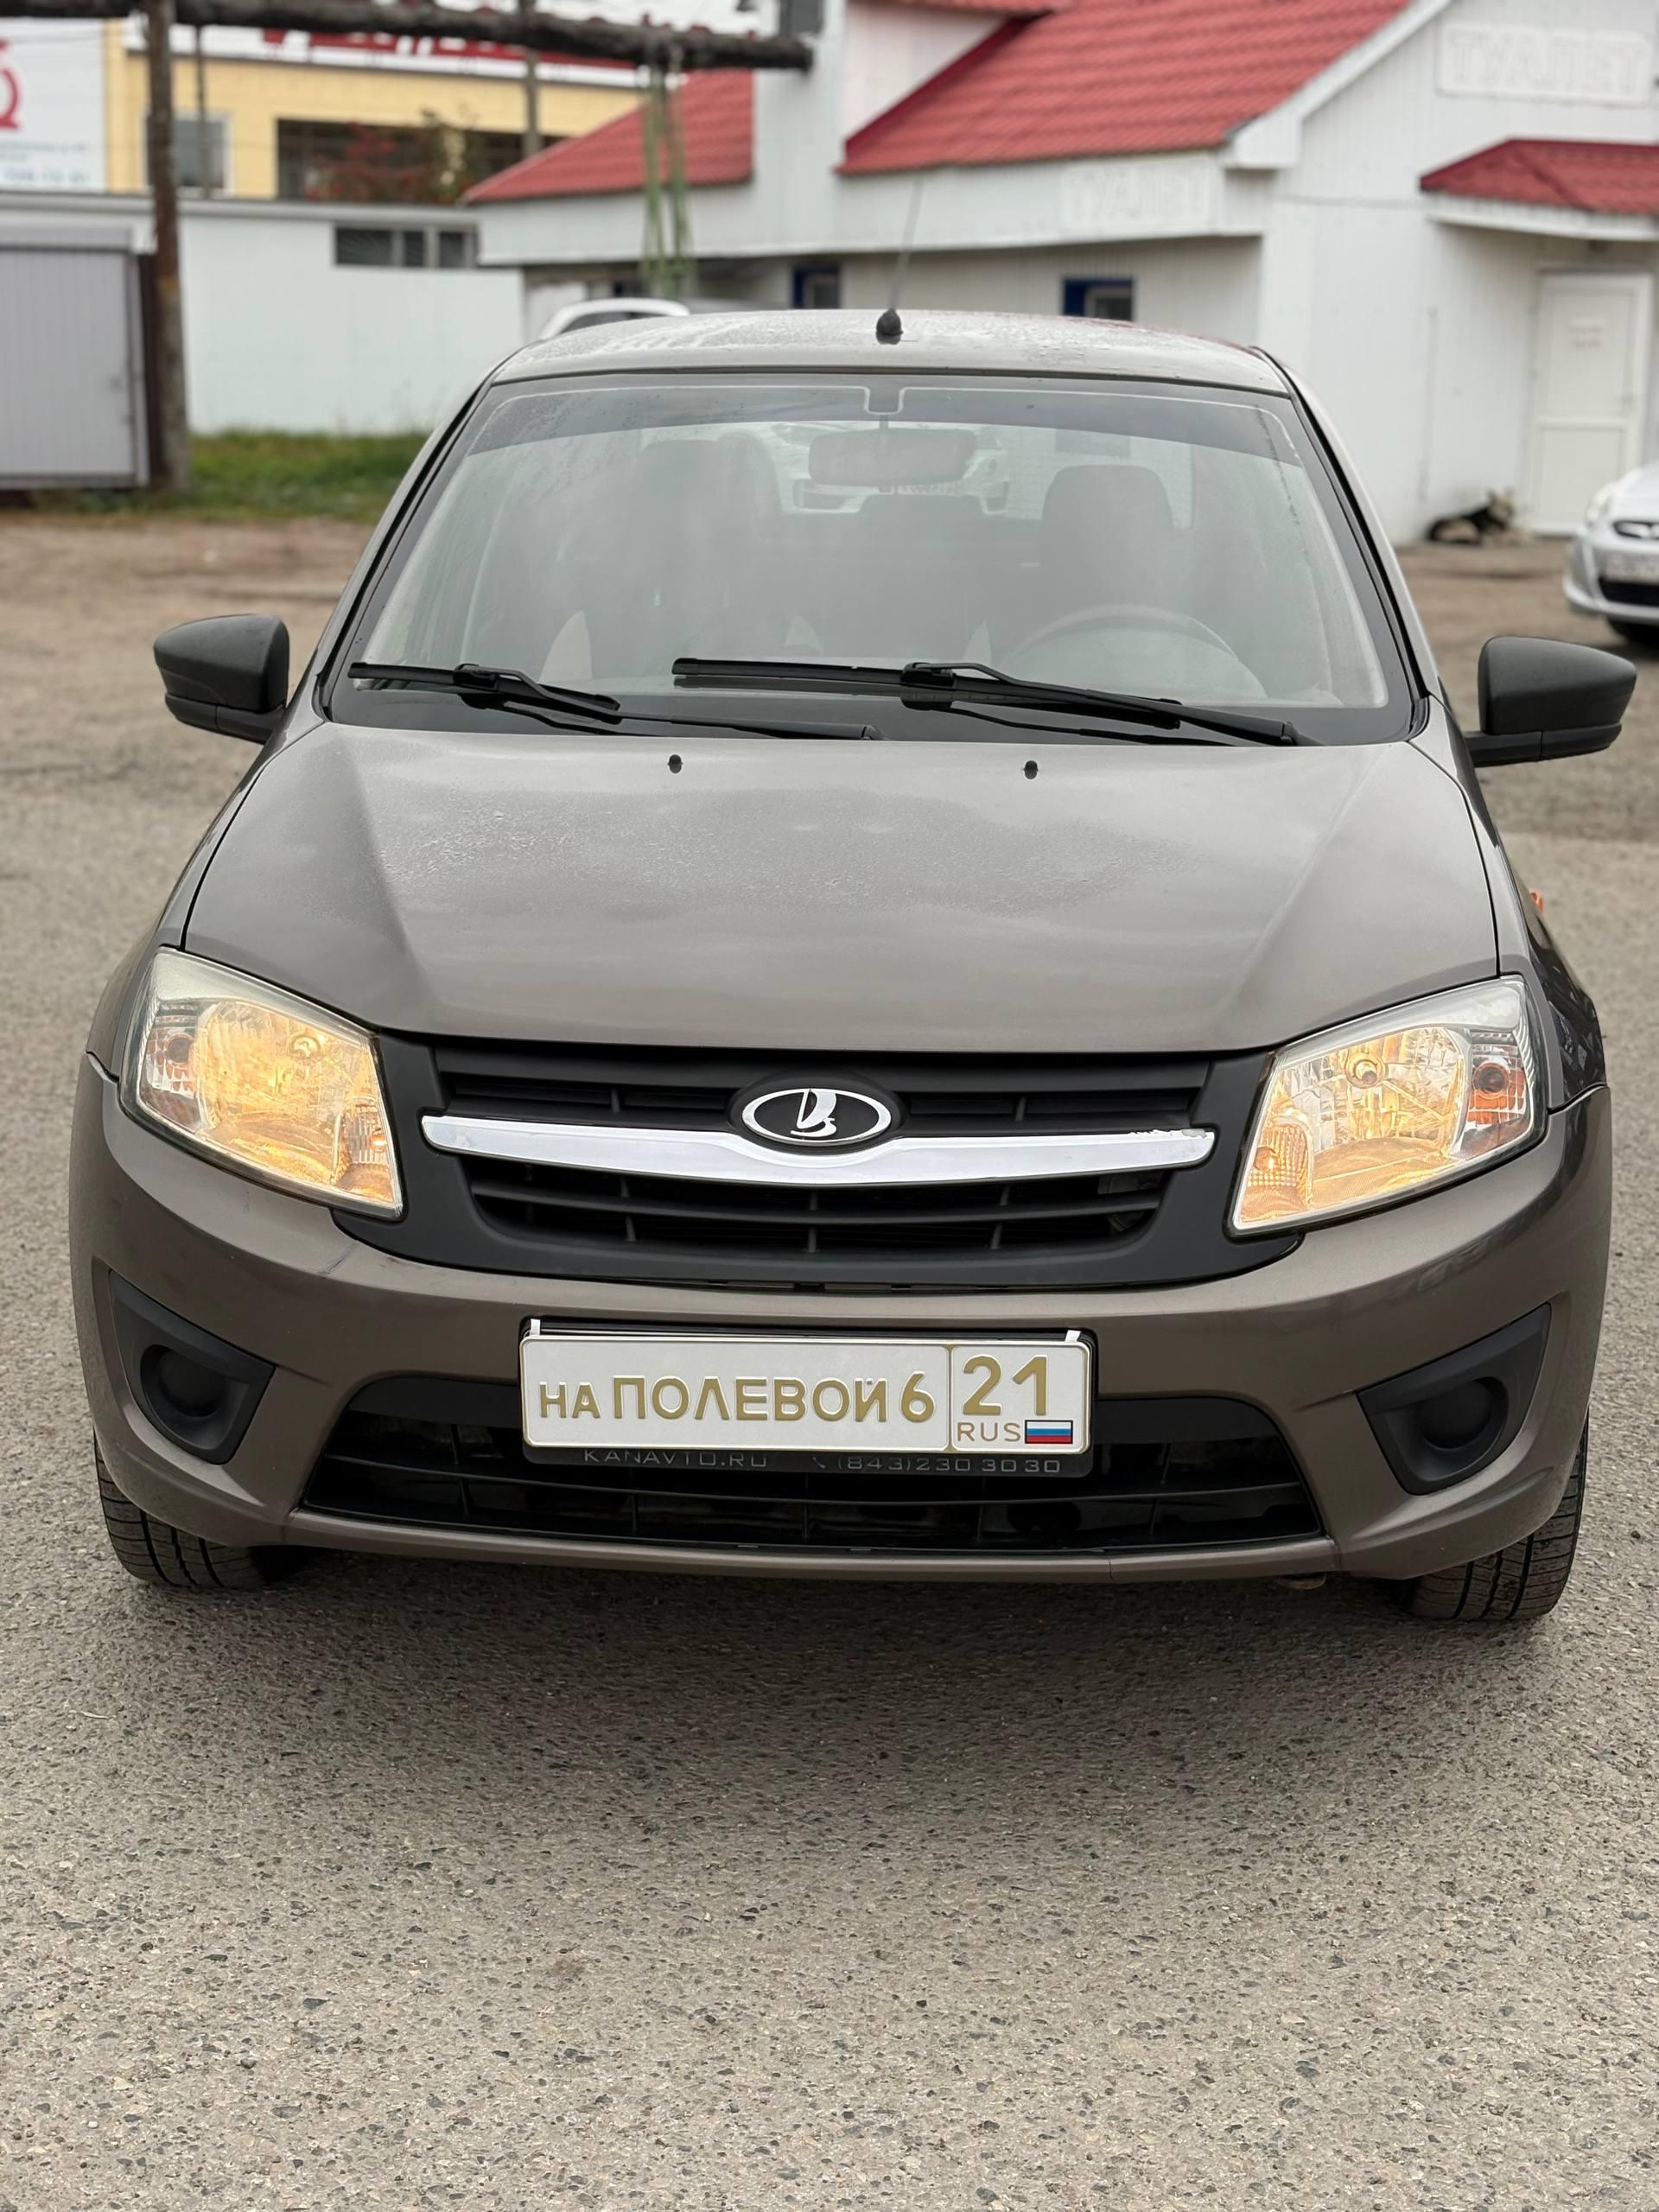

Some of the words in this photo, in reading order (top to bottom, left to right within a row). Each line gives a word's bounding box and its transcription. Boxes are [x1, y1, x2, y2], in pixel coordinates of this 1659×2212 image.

[962, 1354, 1048, 1417] 21
[538, 1381, 601, 1420] НА
[612, 1374, 889, 1423] ПОЛЕВОЙ
[899, 1370, 936, 1423] 6
[956, 1421, 1022, 1442] RUS
[583, 1449, 766, 1468] KANAVTO.RU
[981, 1456, 1017, 1473] 30
[1024, 1457, 1061, 1474] 30
